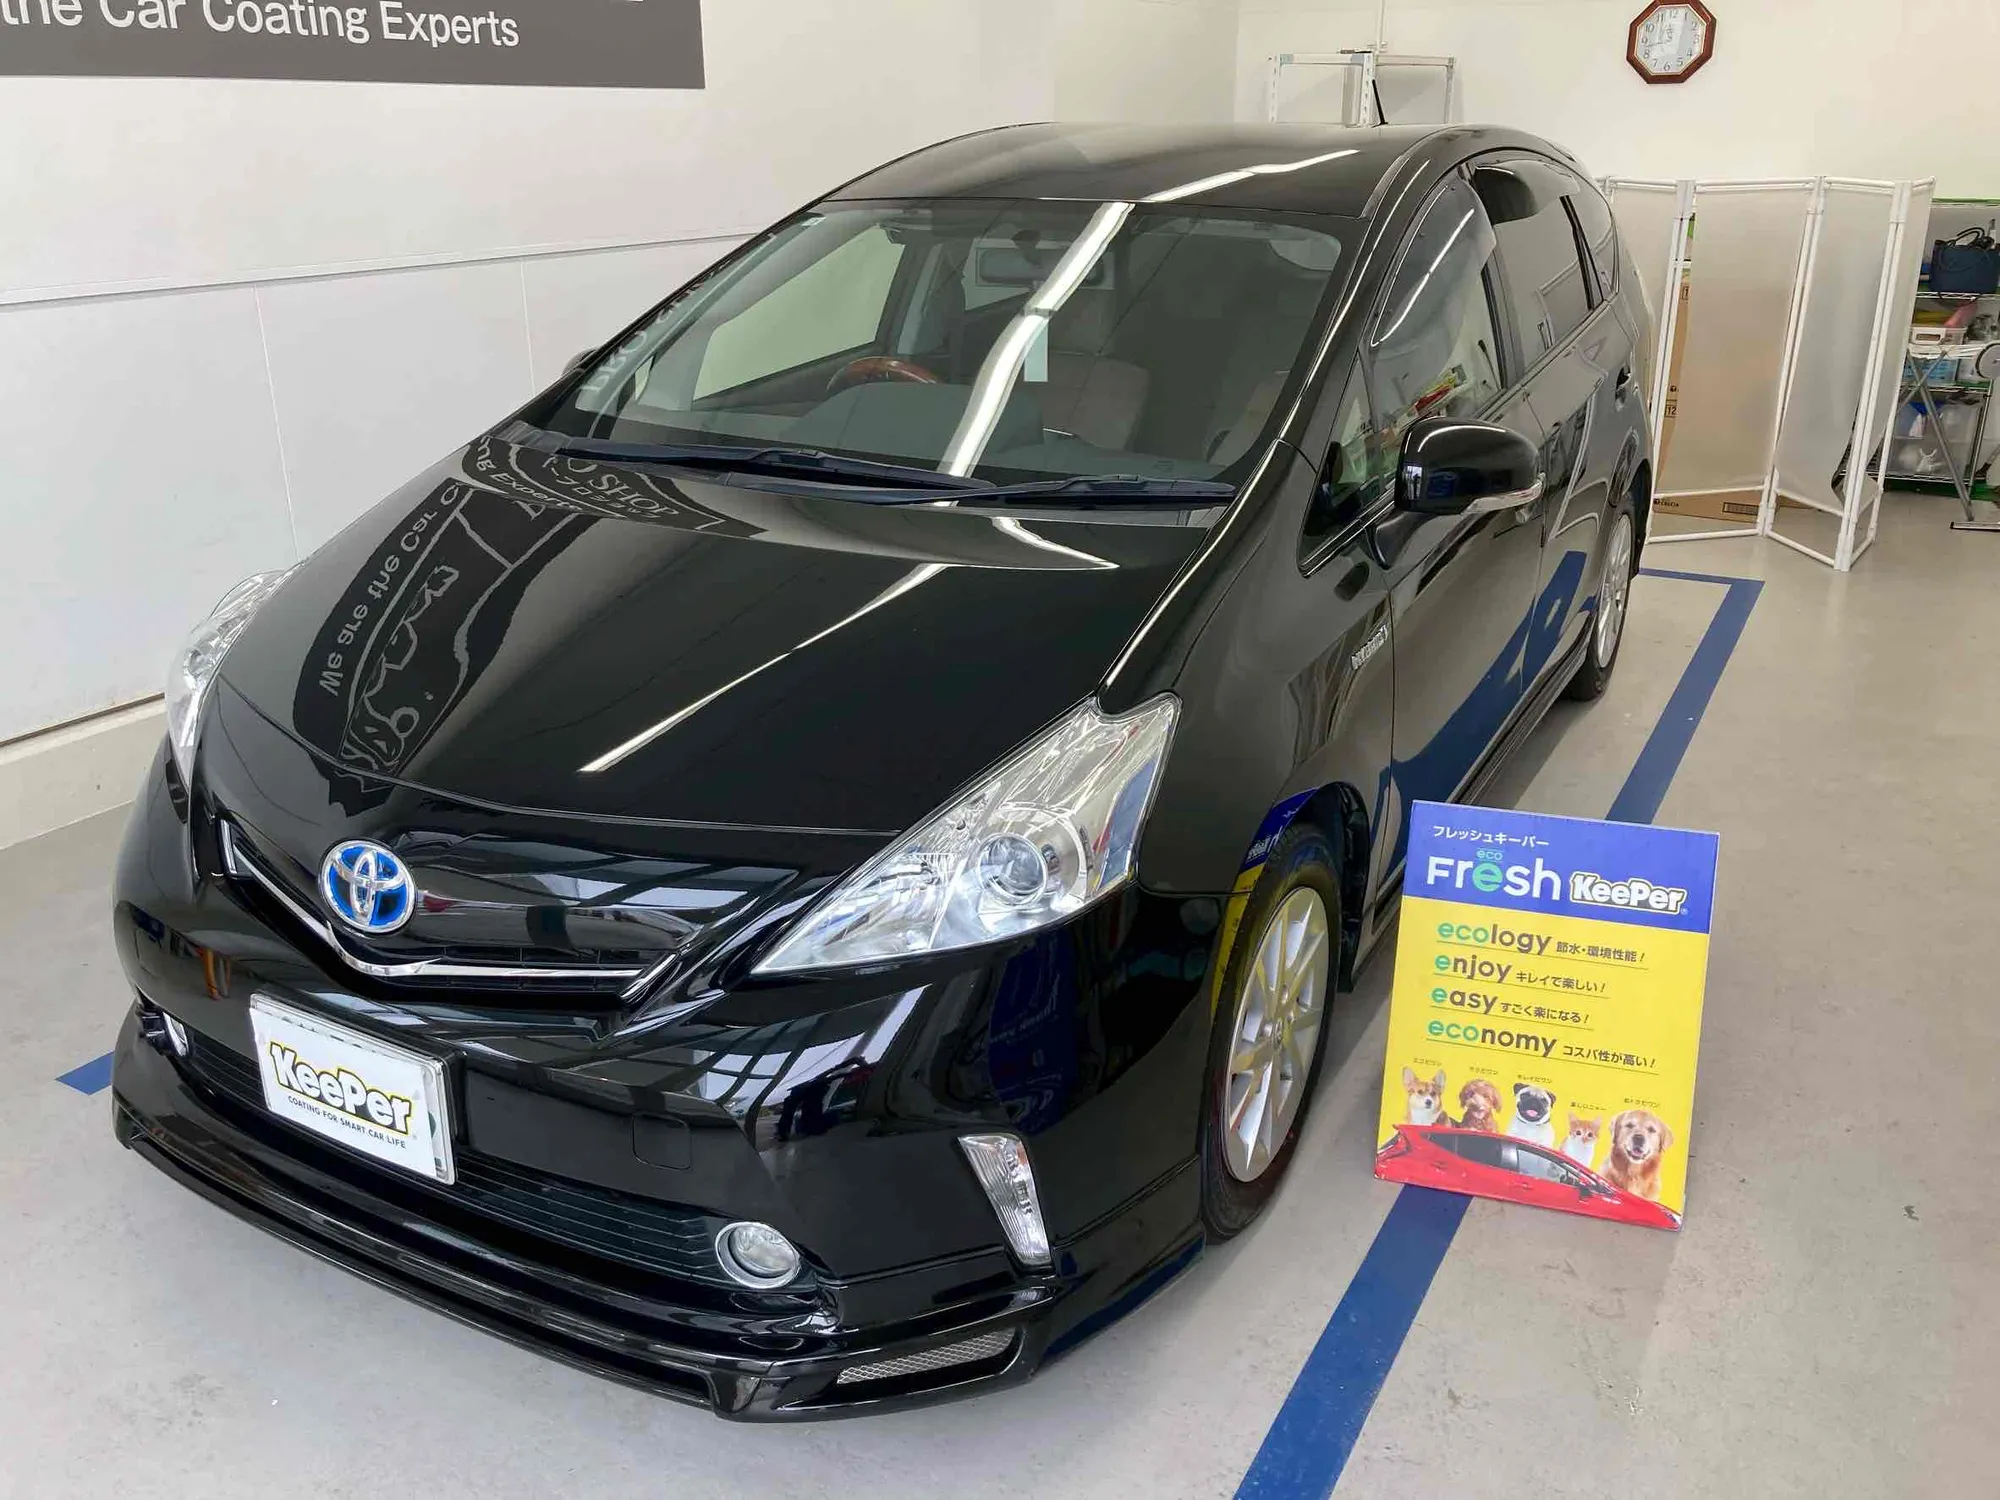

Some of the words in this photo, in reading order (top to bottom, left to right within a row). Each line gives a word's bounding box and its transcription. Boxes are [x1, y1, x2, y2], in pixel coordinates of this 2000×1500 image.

[100, 0, 187, 29] Car
[203, 0, 371, 44] Coating
[381, 0, 520, 47] Experts
[1476, 849, 1503, 861] eco
[1427, 855, 1561, 901] Fresh
[1570, 871, 1687, 914] KeePer
[1437, 922, 1552, 956] ecology
[1434, 954, 1513, 984] enjoy
[1431, 987, 1499, 1015] easy
[1428, 1020, 1558, 1058] economy
[270, 1041, 412, 1135] KeePer
[287, 1096, 321, 1116] COATING
[323, 1110, 339, 1123] FOR
[340, 1117, 366, 1134] SMART
[368, 1129, 385, 1142] CAR
[386, 1135, 407, 1149] LIFE
